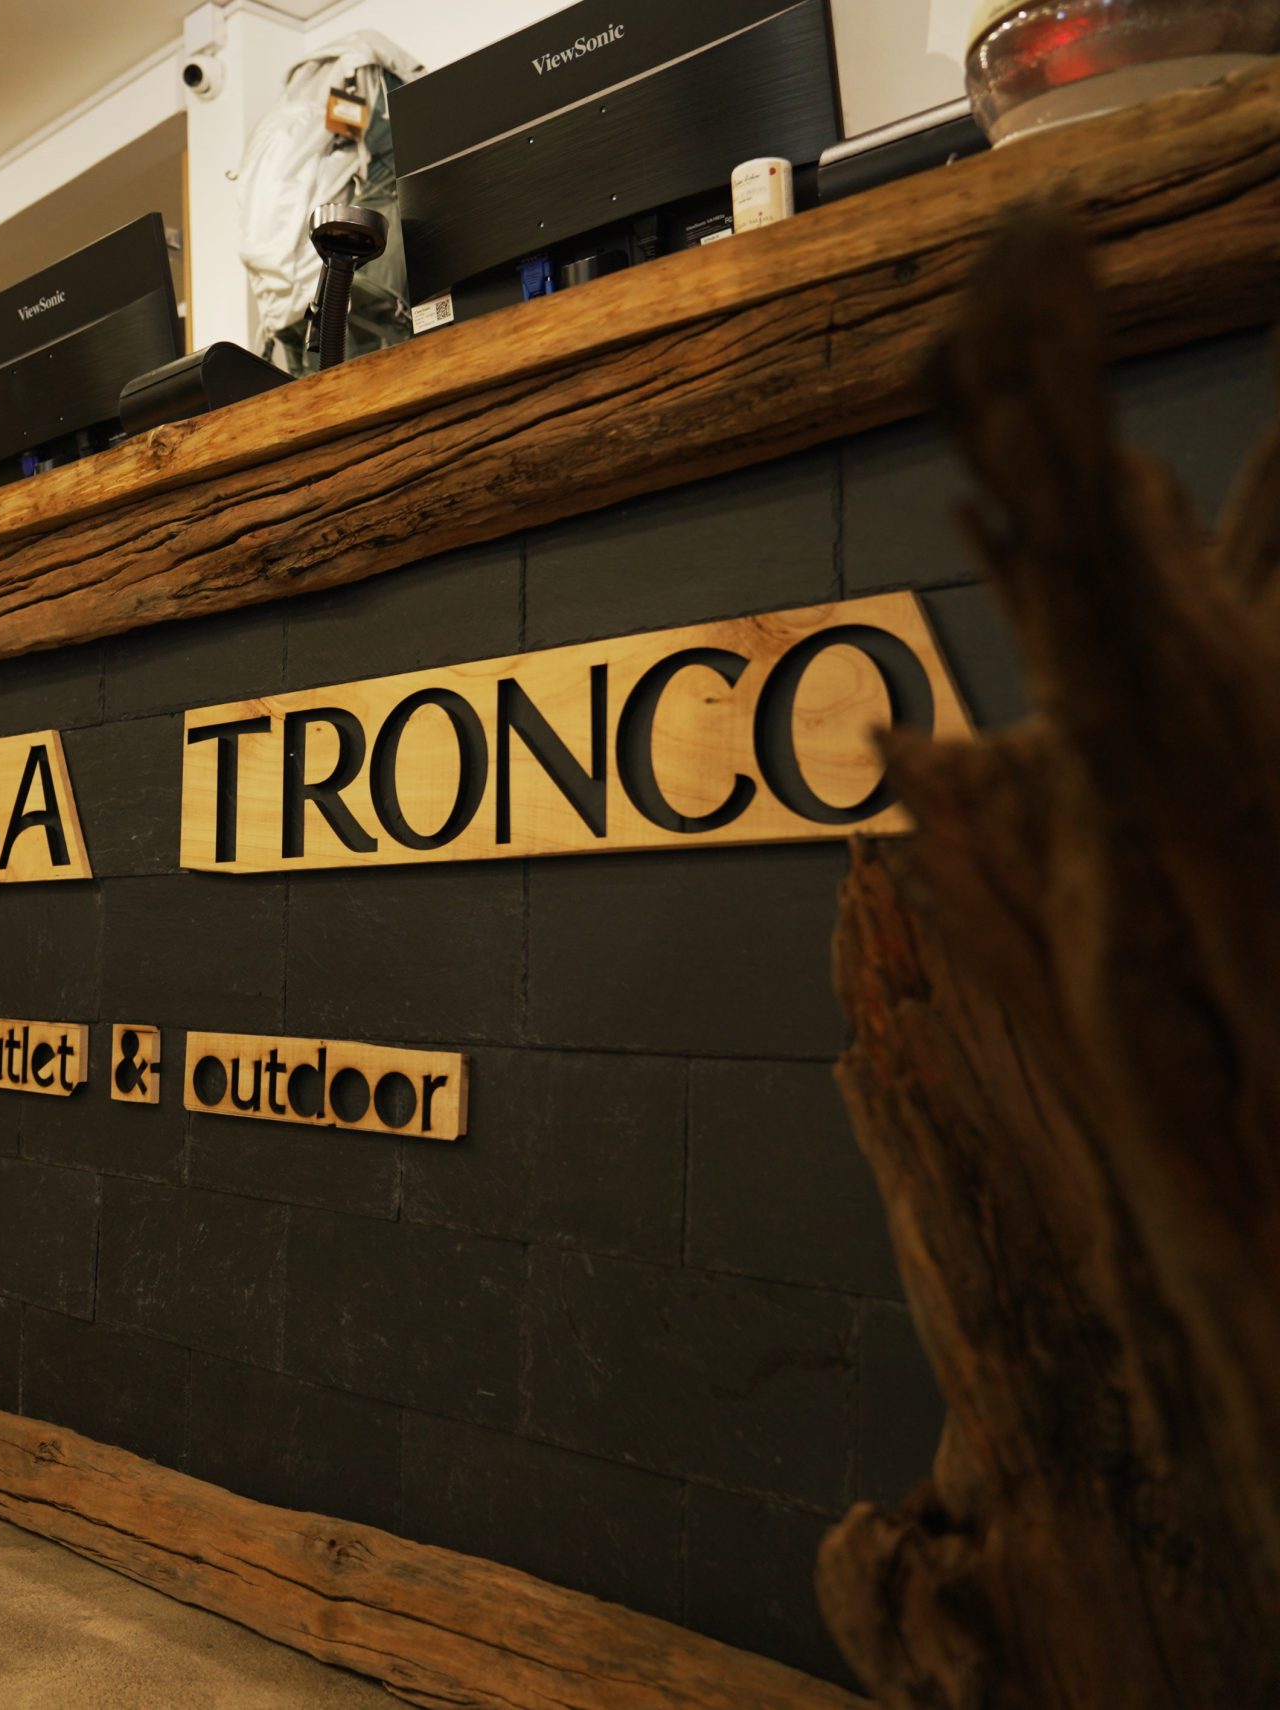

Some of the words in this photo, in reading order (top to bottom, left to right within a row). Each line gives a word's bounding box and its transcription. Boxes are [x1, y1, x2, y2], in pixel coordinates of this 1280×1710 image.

[531, 23, 625, 75] ViewSonic
[17, 290, 66, 321] ViewSonic
[187, 624, 935, 864] TRONCO
[115, 1030, 161, 1095] &
[192, 1047, 448, 1132] outdoor
